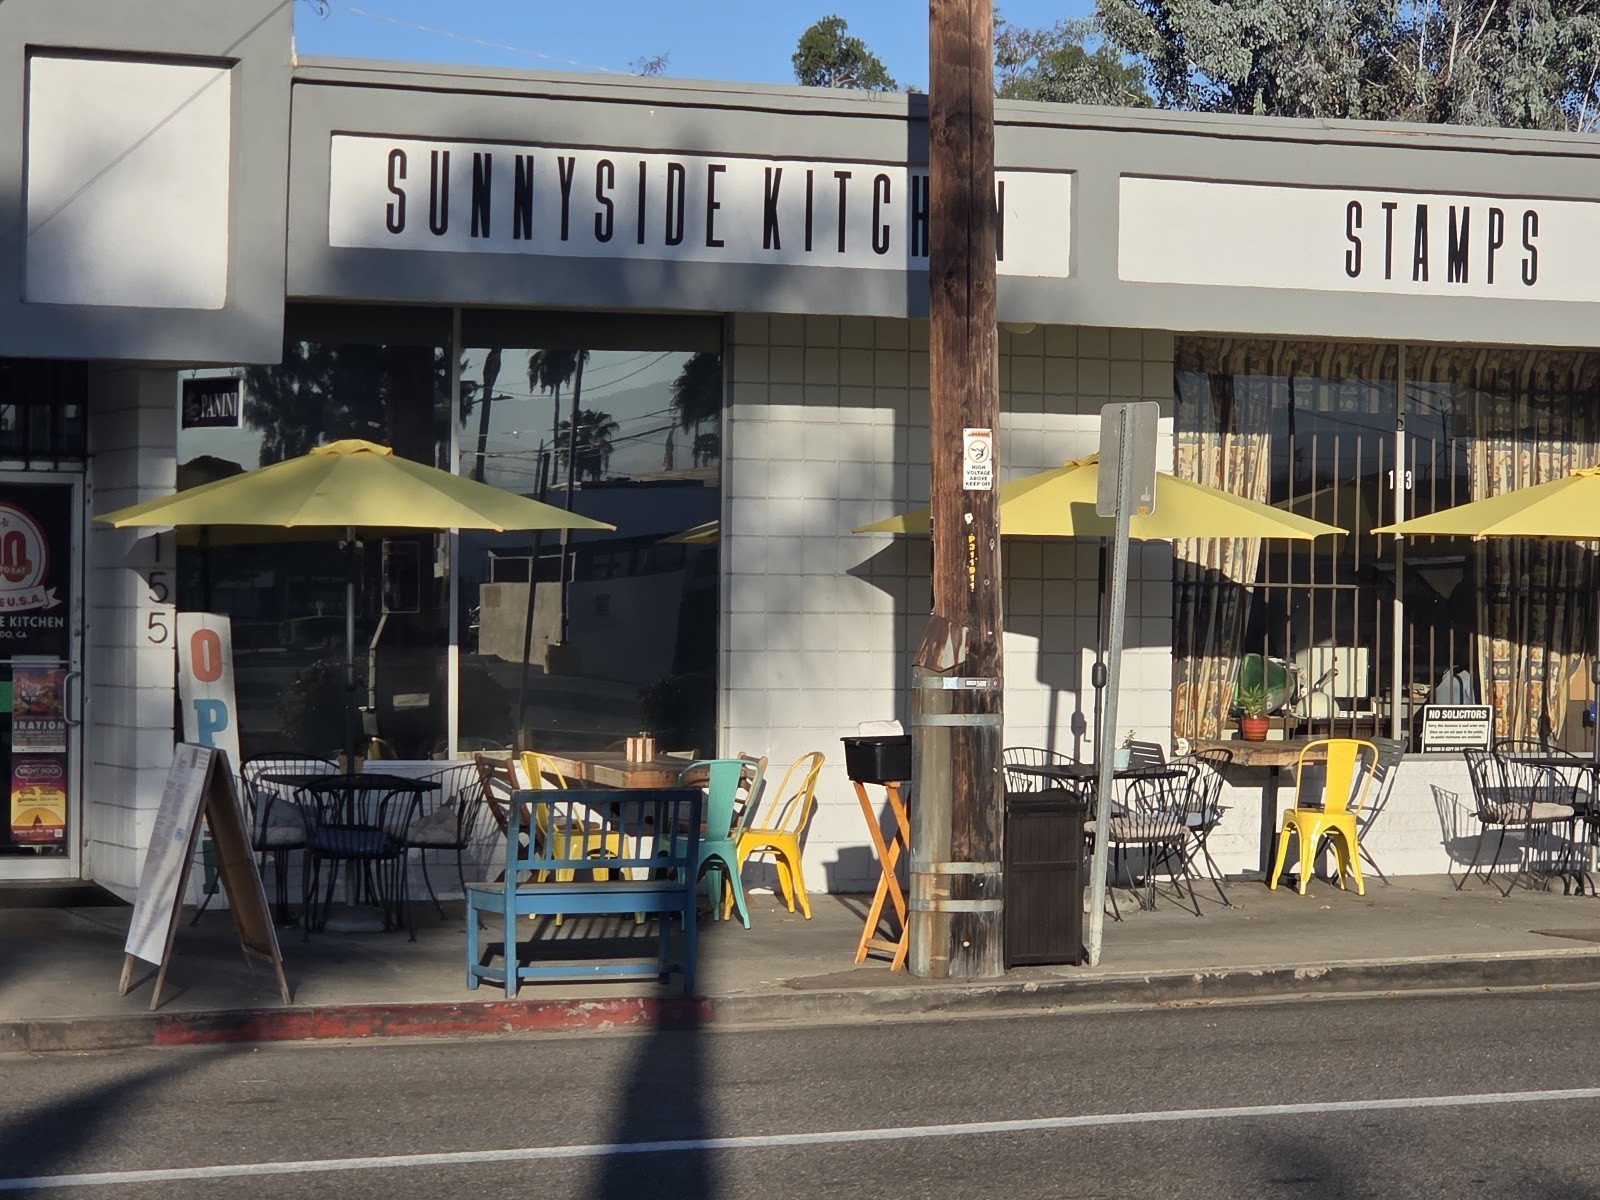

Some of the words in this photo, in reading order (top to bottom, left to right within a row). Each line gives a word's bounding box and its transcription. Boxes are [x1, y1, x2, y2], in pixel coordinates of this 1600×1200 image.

[386, 148, 727, 248] SUNNYSIDE
[763, 167, 1005, 262] KITCHN
[1345, 200, 1539, 286] STAMPS
[201, 392, 238, 418] PANINI
[1388, 470, 1412, 489] 13
[7, 594, 44, 607] U.S.A.
[9, 616, 64, 628] KITCHEN
[16, 630, 27, 639] CA
[1429, 709, 1440, 719] NO
[1442, 710, 1487, 719] SOLICITORS
[13, 721, 65, 730] IRATION
